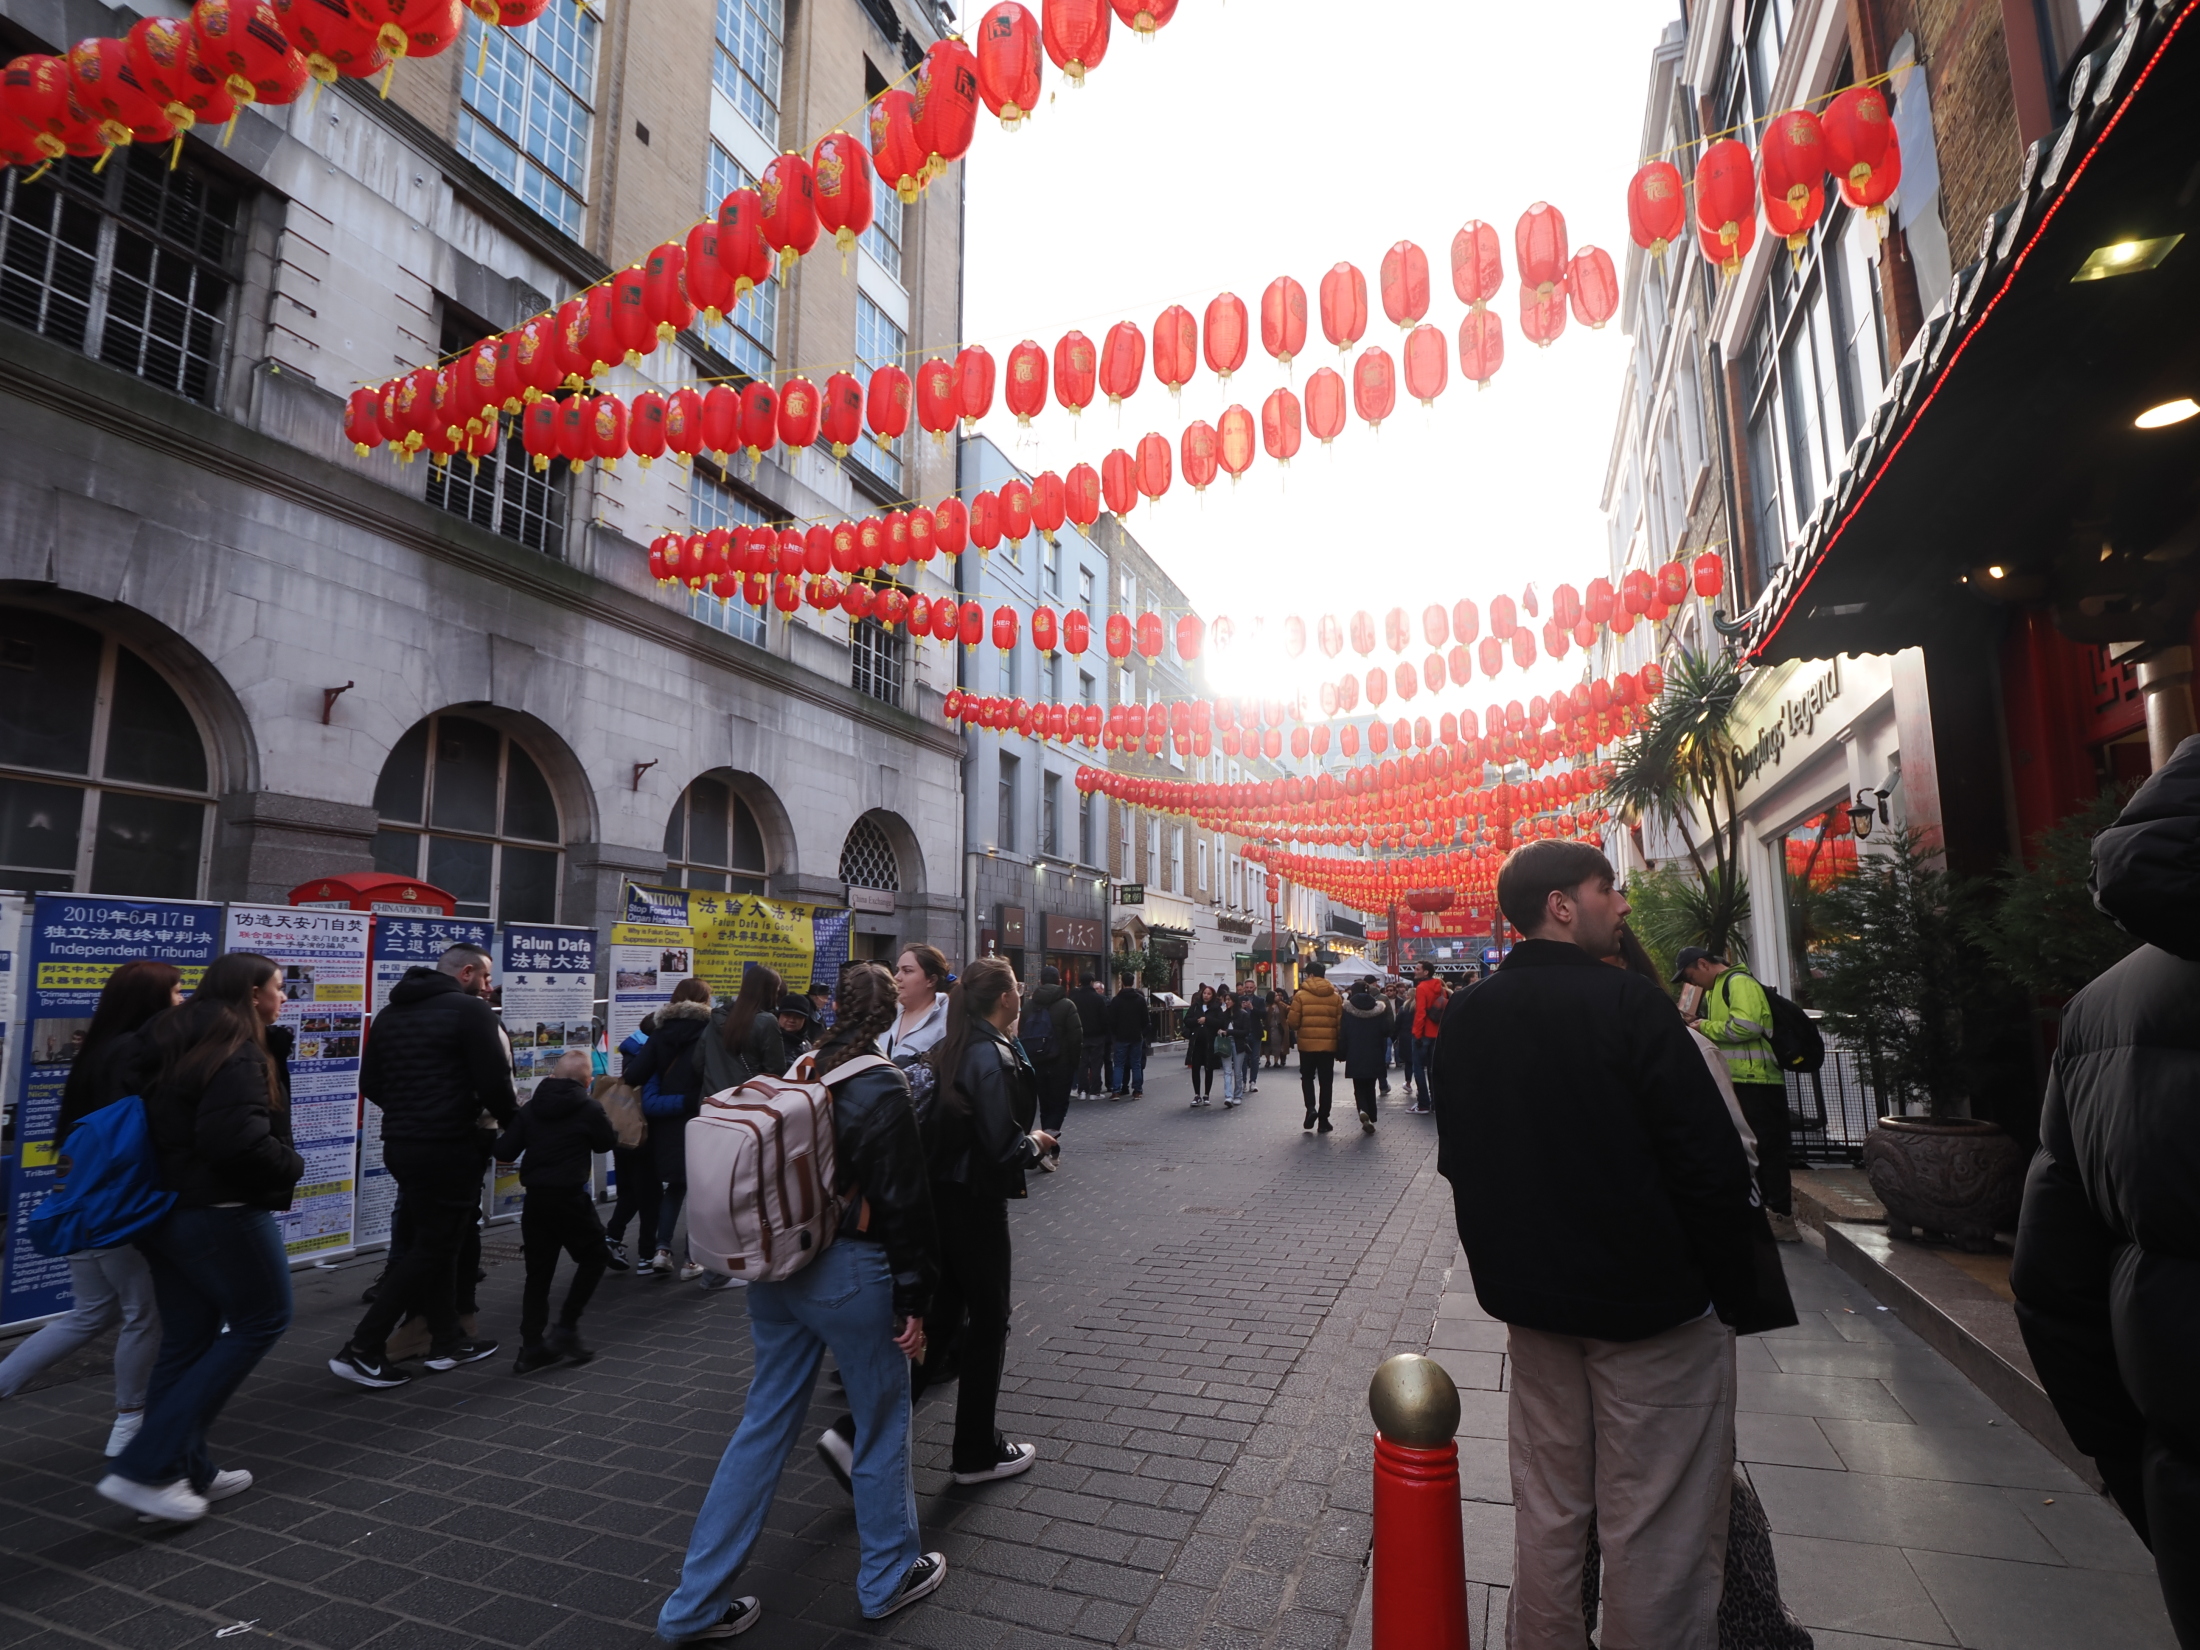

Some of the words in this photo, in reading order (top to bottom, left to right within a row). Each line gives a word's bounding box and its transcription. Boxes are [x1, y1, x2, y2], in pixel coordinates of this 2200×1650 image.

[372, 903, 424, 913] CHINATOWN
[852, 894, 867, 904] China
[868, 896, 892, 908] Exchange
[628, 904, 647, 914] Stop
[649, 906, 672, 916] Forced
[673, 908, 687, 917] Live
[697, 896, 805, 922] 法輪大法好
[63, 906, 196, 927] 2019年6月17日
[234, 913, 364, 932] 伪造天安门自焚
[627, 913, 651, 922] Organ
[652, 915, 687, 925] Harvesting
[385, 921, 486, 939] 天要灭中共
[713, 917, 735, 927] Falun
[739, 919, 759, 928] Dafa
[762, 920, 770, 929] is
[774, 922, 794, 931] Good
[43, 925, 213, 944] 独立法庭终审判决
[627, 927, 640, 935] Why
[664, 929, 680, 937] Gong
[385, 939, 483, 954] 三退保
[512, 935, 553, 950] Falun
[558, 937, 591, 952] Dafa
[623, 936, 657, 945] Suppressed
[50, 942, 148, 958] Independent
[151, 945, 208, 959] Tribunal
[693, 948, 729, 956] Truthfulness
[733, 949, 769, 958] Compassion
[772, 951, 808, 959] Forbearance
[510, 953, 592, 969] 法輪大法
[515, 975, 528, 985] 真
[545, 976, 557, 985] 善
[36, 990, 70, 998] "Crimes
[72, 991, 102, 999] against
[25, 1114, 51, 1122] years
[10, 1284, 31, 1294] with
